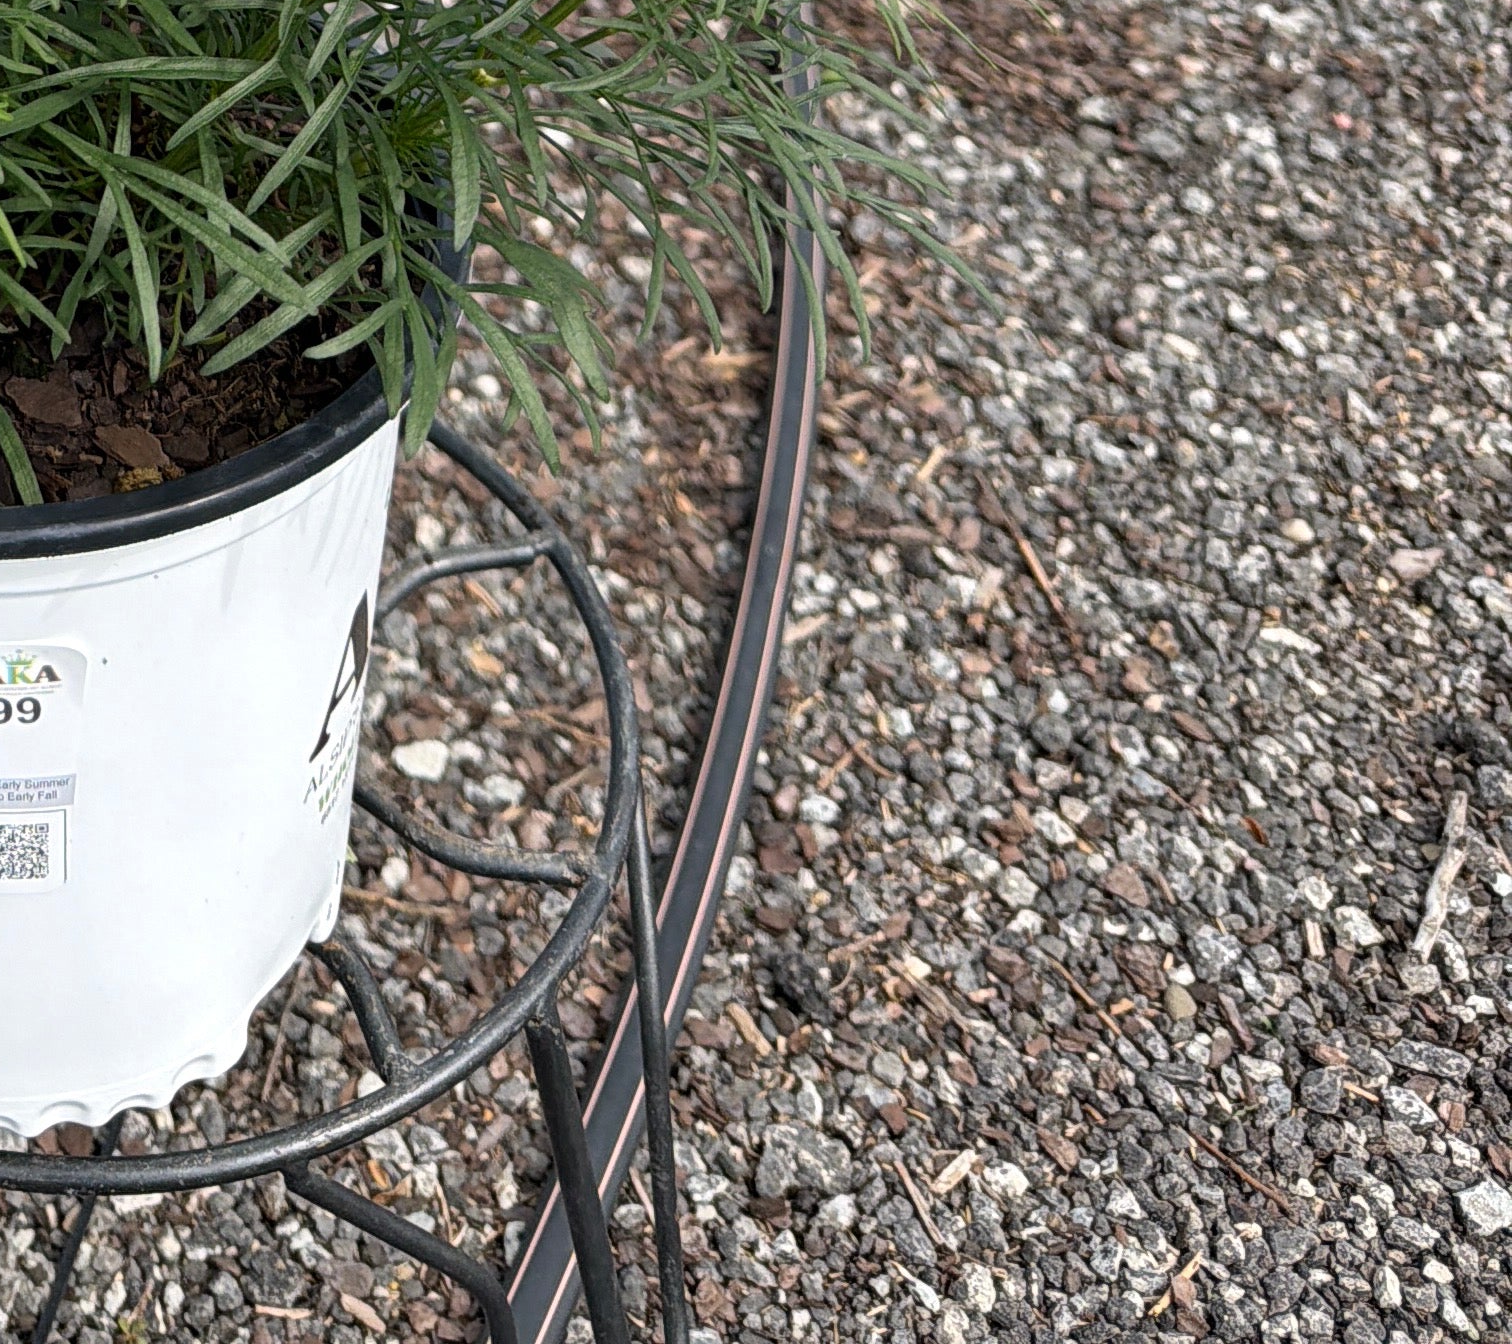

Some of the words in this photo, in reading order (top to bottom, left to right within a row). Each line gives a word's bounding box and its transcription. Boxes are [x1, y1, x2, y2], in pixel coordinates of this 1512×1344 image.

[24, 777, 70, 790] Summer
[8, 792, 34, 802] Early
[37, 790, 58, 800] Fall
